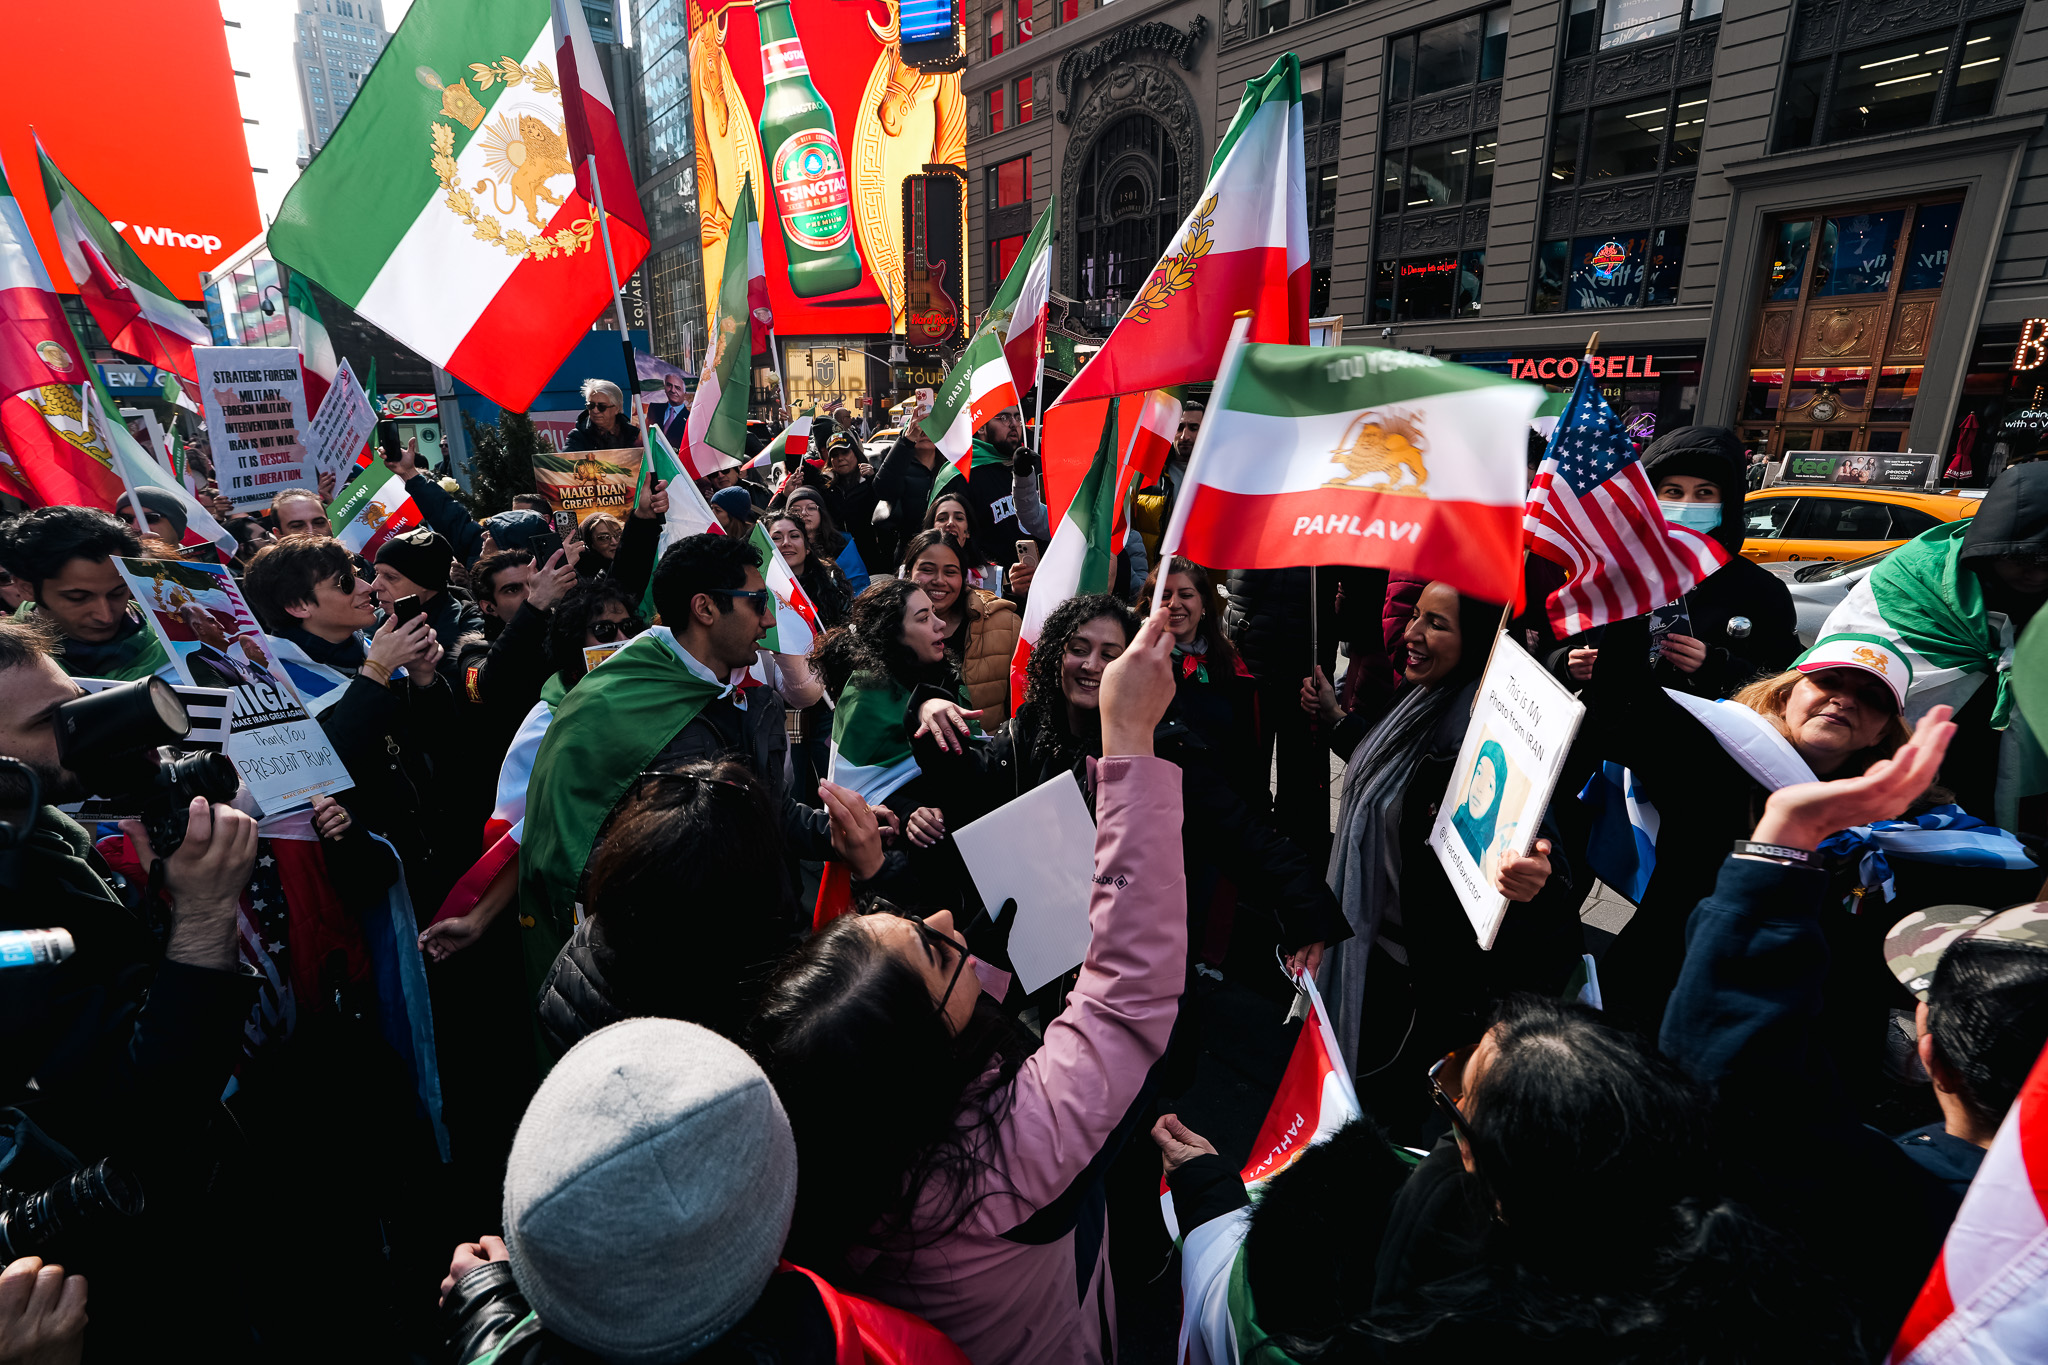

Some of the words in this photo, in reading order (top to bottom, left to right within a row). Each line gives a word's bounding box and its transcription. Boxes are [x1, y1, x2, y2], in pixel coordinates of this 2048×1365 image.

[1056, 14, 1205, 124] Paramount
[780, 176, 847, 203] TSINGTAO
[1120, 190, 1137, 203] 1501
[806, 216, 842, 229] PREMIUM
[814, 224, 837, 233] LAGER
[133, 223, 223, 255] Whop
[632, 271, 644, 327] SQUARE
[911, 313, 934, 325] Hard
[934, 313, 955, 327] Rock
[1507, 357, 1579, 379] TACO
[1589, 355, 1661, 378] BELL
[213, 370, 262, 384] STRATEGIC
[263, 368, 298, 383] FOREIGN
[238, 388, 281, 403] MILITARY
[222, 405, 256, 417] FOREIGN
[255, 402, 292, 416] MILITARY
[224, 419, 280, 434] INTERVENTION
[280, 418, 295, 429] FOR
[2005, 419, 2027, 428] with
[228, 440, 249, 451] IRAN
[248, 438, 258, 450] IS
[259, 437, 274, 448] NOT
[238, 456, 247, 469] IT
[248, 455, 259, 467] IS
[1792, 458, 1837, 475] ted
[1885, 468, 1913, 476] peacock
[232, 476, 241, 489] IT
[243, 475, 253, 487] IS
[559, 485, 595, 500] MAKE
[595, 483, 627, 497] IRAN
[562, 498, 594, 510] GREAT
[595, 495, 626, 508] AGAIN
[1292, 513, 1422, 544] PAHLAVI
[1505, 675, 1520, 701] This
[1519, 692, 1528, 710] is
[1527, 700, 1542, 728] My
[231, 716, 252, 729] MAKE
[252, 714, 269, 724] IRAN
[269, 711, 287, 721] GREAT
[287, 708, 306, 719] AGAIN
[1489, 689, 1509, 721] Photo
[1509, 710, 1525, 740] from
[1525, 729, 1545, 762] IRAN
[245, 725, 287, 747] Thank
[282, 725, 306, 743] You
[238, 752, 300, 783] PRESIDENT
[296, 746, 333, 768] TRUMP
[282, 791, 296, 800] MAKE
[297, 787, 310, 796] IRAN
[1745, 843, 1809, 861] FREEDOM
[1250, 1113, 1305, 1178] PAHLAVI
